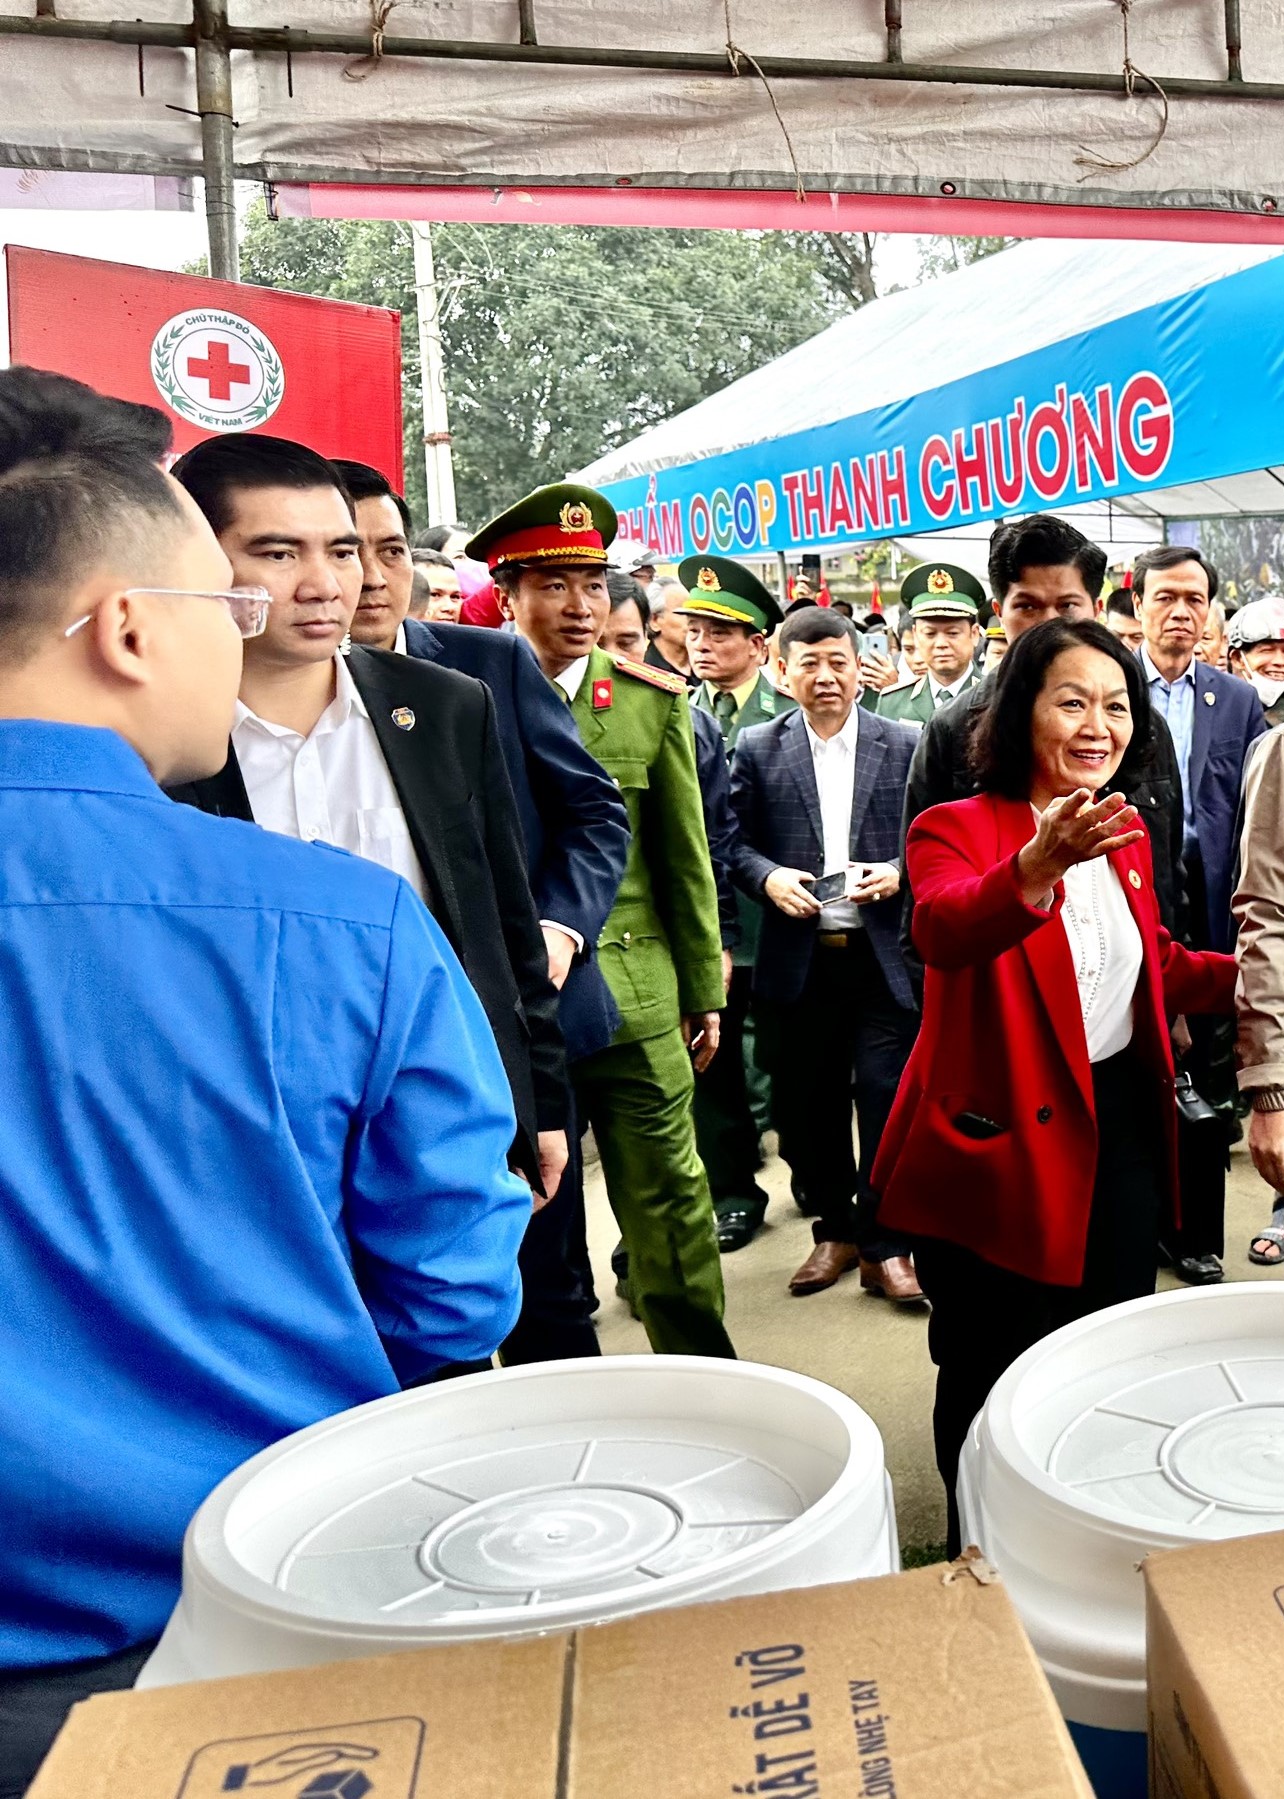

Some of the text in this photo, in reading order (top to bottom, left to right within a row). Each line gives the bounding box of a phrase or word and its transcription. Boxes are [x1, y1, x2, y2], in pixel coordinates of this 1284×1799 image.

[221, 418, 243, 426] NAM
[690, 479, 777, 554] OCOP
[782, 445, 910, 541] THANH
[919, 370, 1174, 520] CHƯƠNG
[729, 1692, 813, 1740] DỄ
[848, 1679, 897, 1799] ÒNG NHẸ TAY
